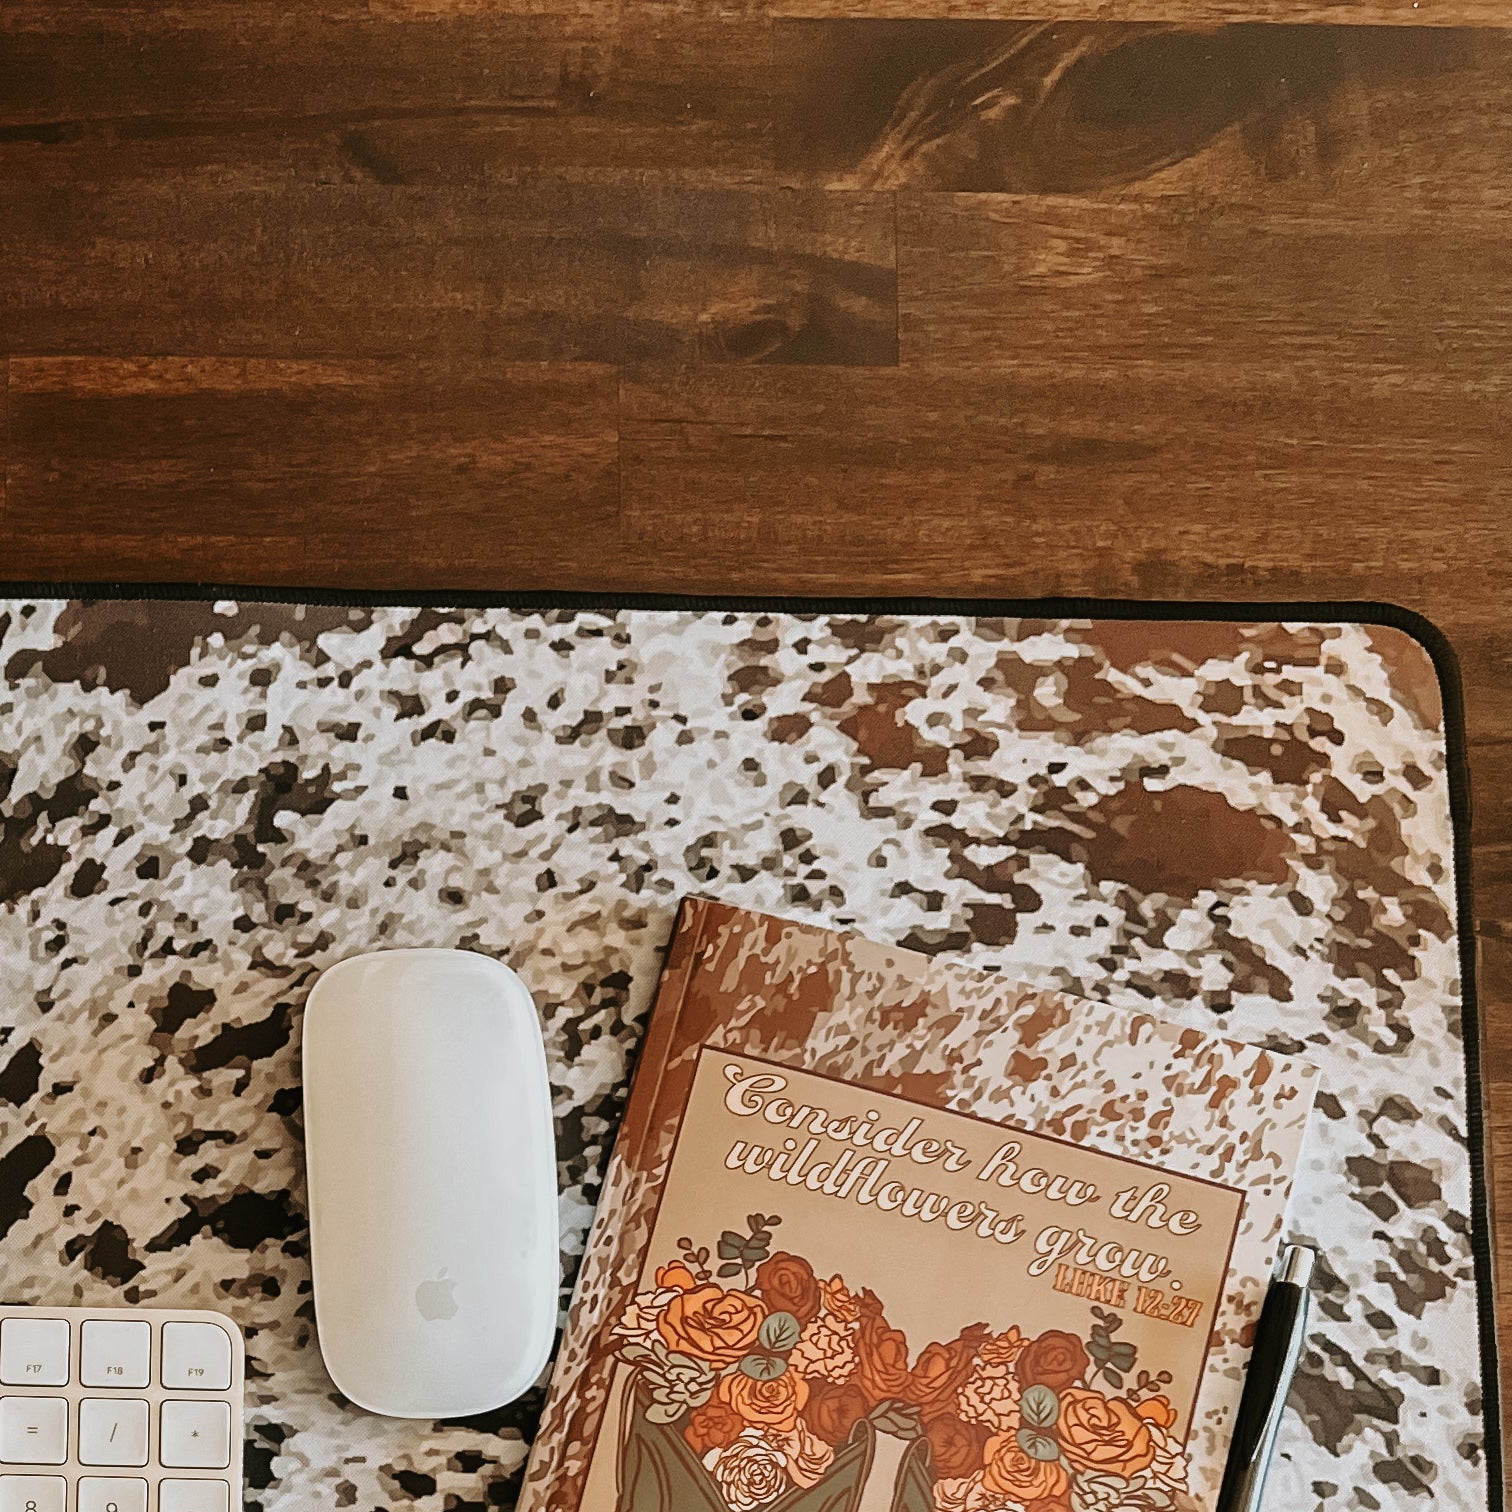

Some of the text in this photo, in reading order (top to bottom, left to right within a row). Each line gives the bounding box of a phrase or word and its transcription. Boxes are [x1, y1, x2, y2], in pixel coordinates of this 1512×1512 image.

[723, 1063, 1202, 1235] Consider how the
[724, 1138, 1183, 1291] wildflowers grow.
[1133, 1286, 1204, 1328] 12:27
[25, 1364, 43, 1374] F17
[106, 1366, 124, 1376] F18
[187, 1367, 205, 1377] F19
